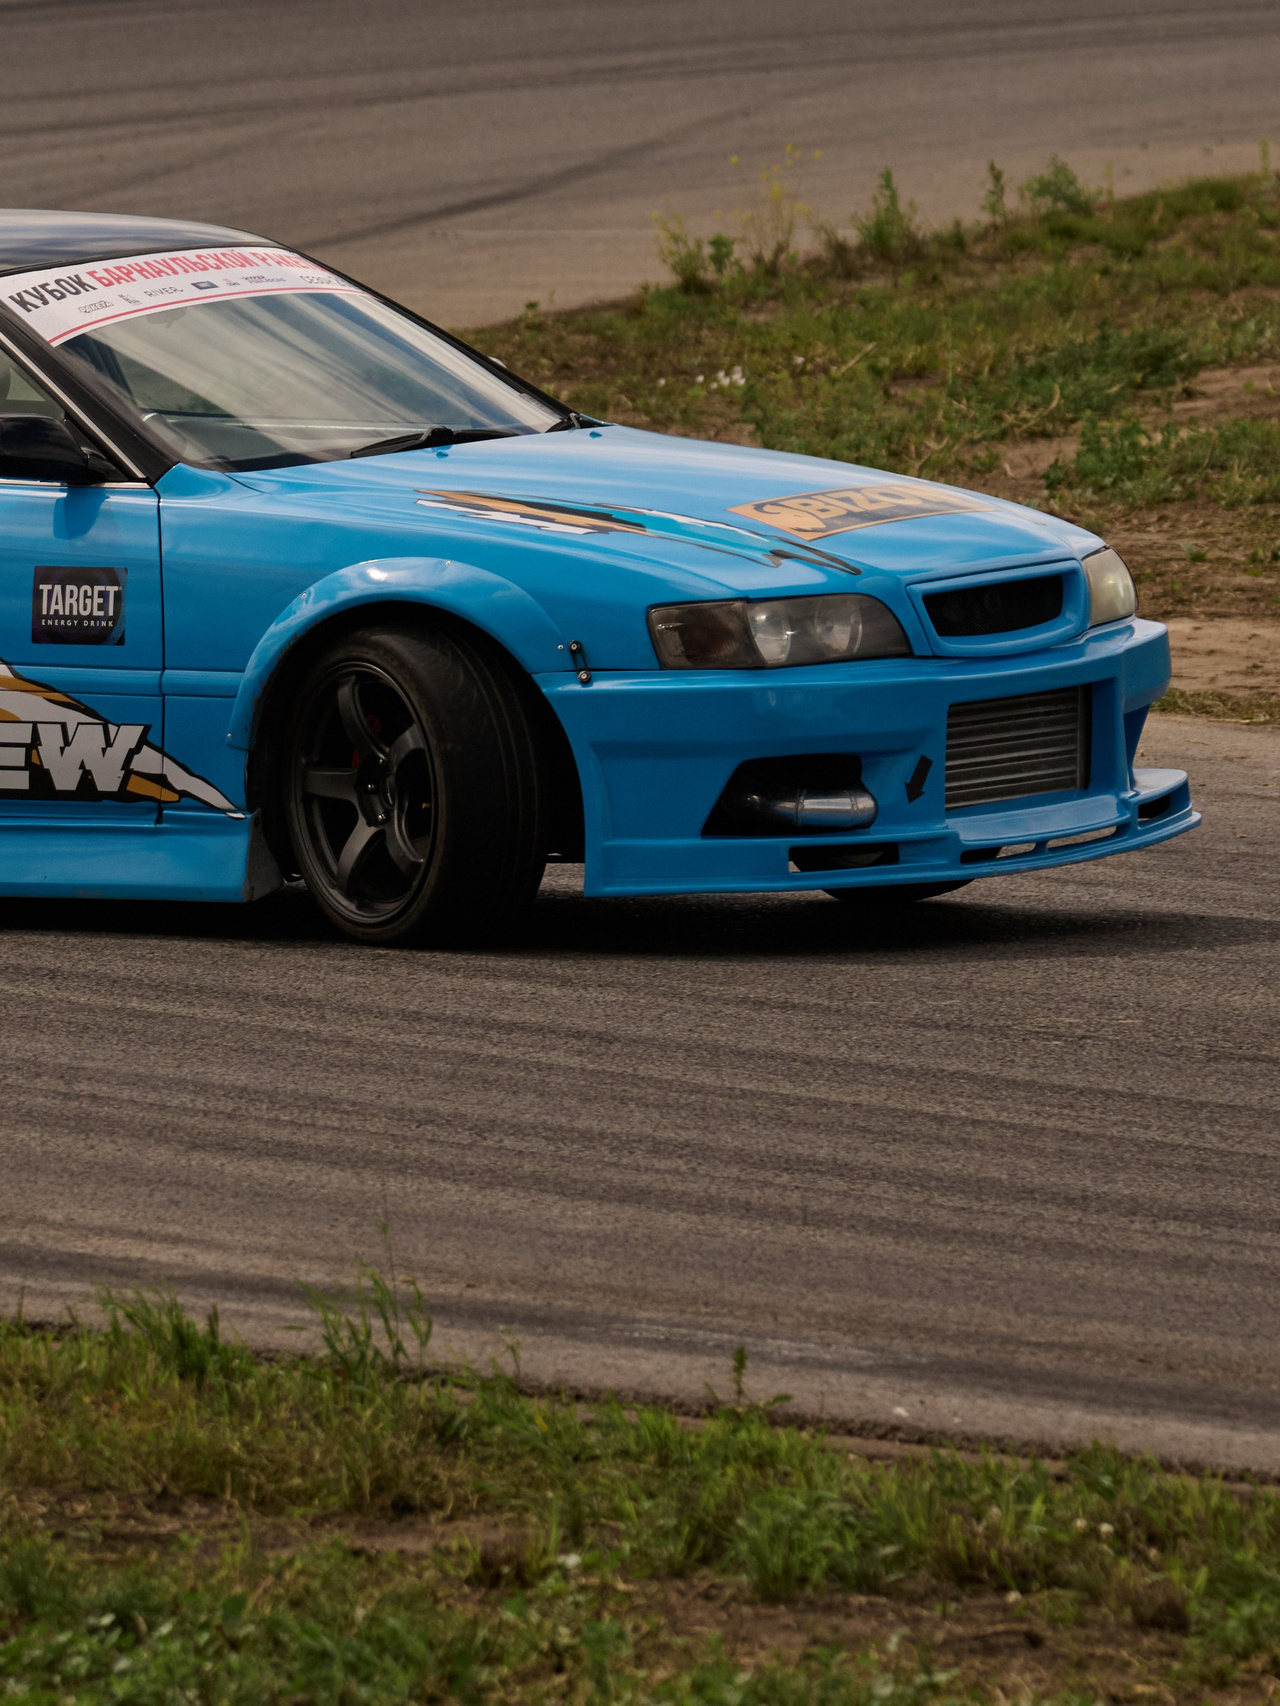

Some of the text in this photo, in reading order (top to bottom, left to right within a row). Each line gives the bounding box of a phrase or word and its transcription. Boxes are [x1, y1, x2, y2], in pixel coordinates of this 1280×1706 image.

[8, 273, 98, 312] КУБОК
[87, 248, 256, 288] БАРНАУЛЬСКОЙ
[144, 285, 183, 298] RIVER
[39, 584, 120, 617] TARGET
